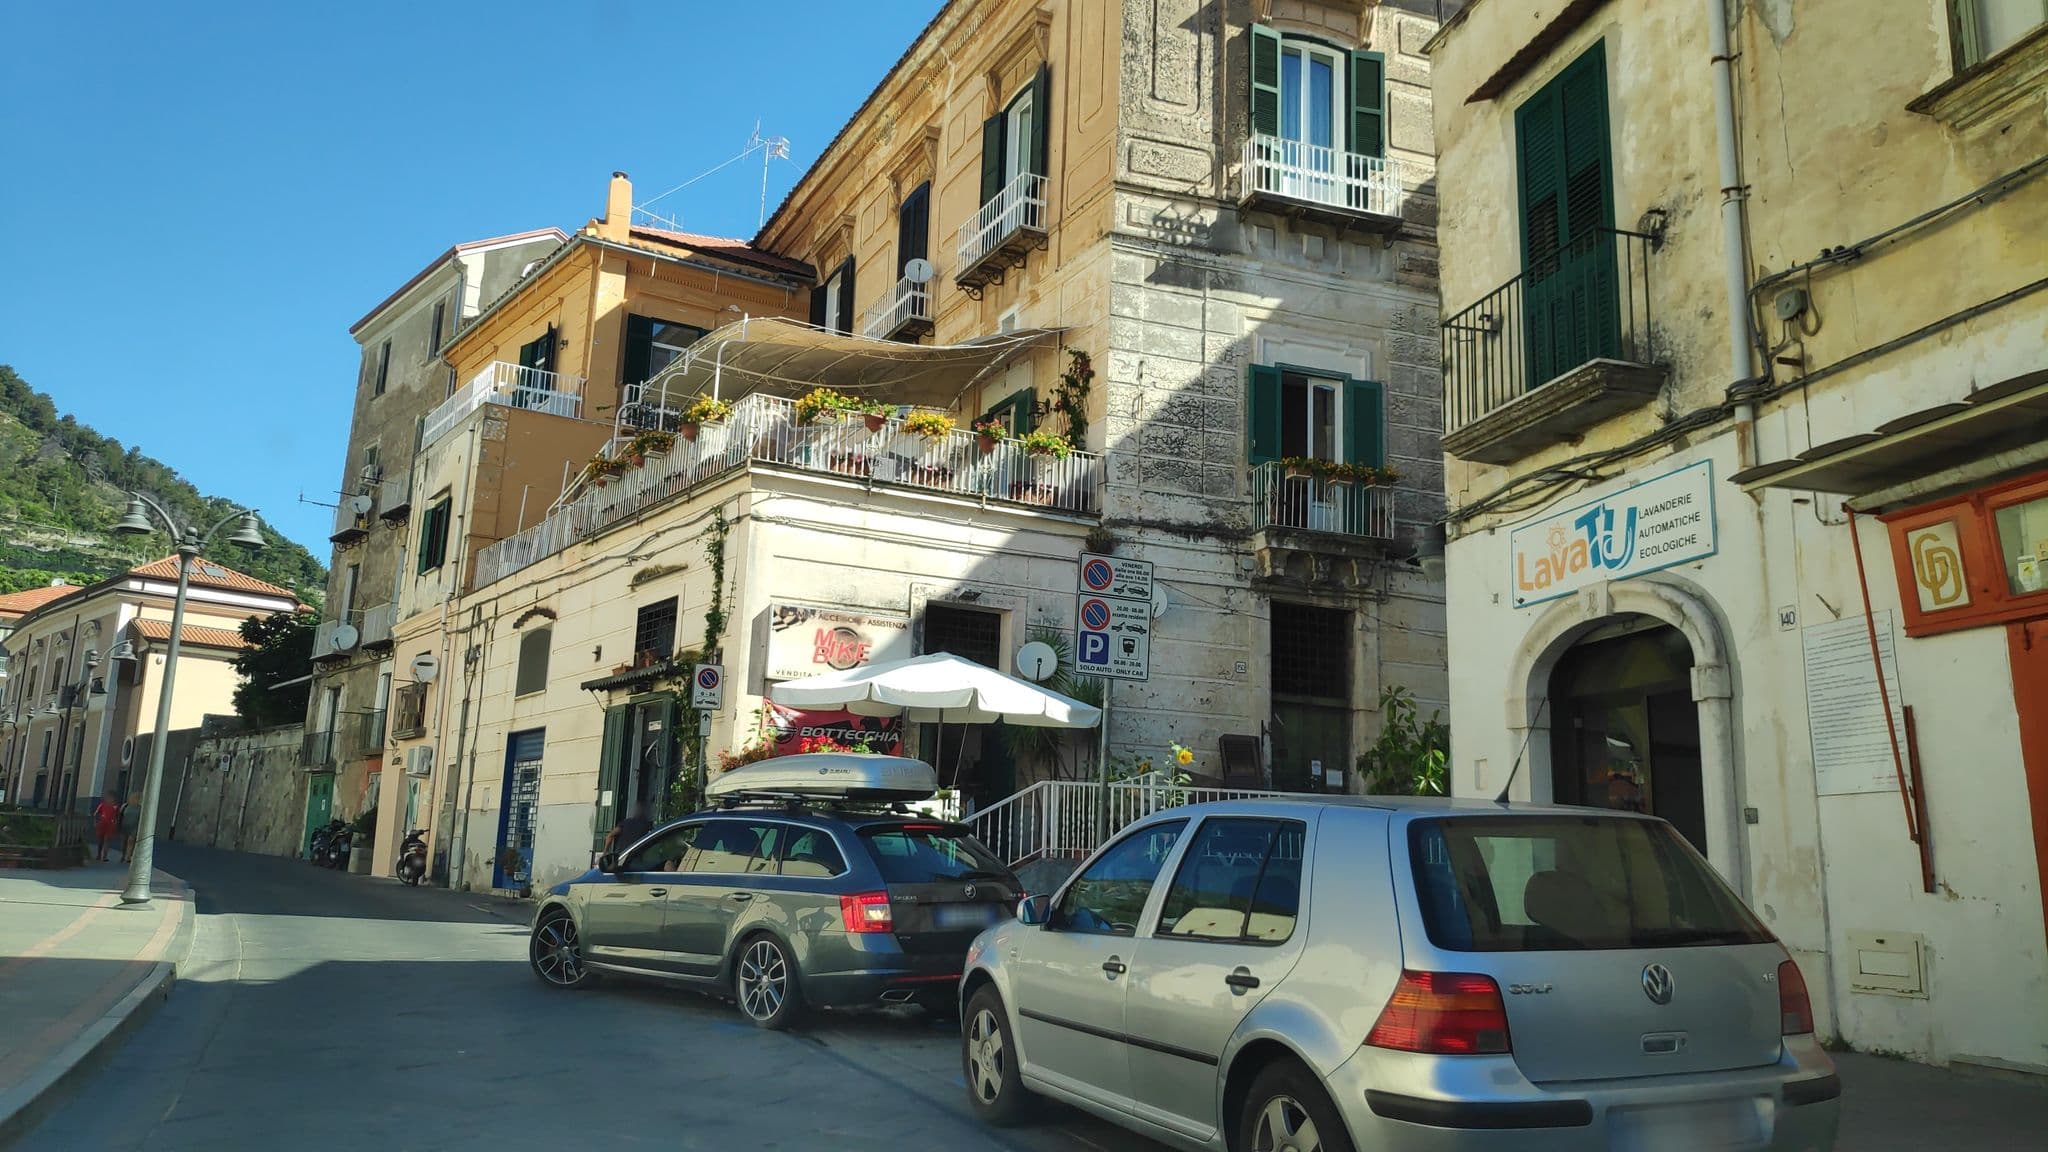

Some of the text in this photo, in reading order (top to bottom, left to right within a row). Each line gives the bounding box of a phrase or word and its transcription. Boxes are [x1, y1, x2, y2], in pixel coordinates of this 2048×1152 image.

[1638, 493, 1692, 519] LAVANDERIE
[1639, 511, 1701, 539] AUTOMATICHE
[1639, 533, 1698, 559] ECOLOGICHE
[867, 619, 907, 630] ASSISTENZA
[1780, 611, 1796, 626] 140
[1085, 634, 1104, 660] P
[776, 669, 812, 677] VENDITA
[800, 726, 899, 742] BOTTECCHIA
[1508, 983, 1553, 995] GOLF
